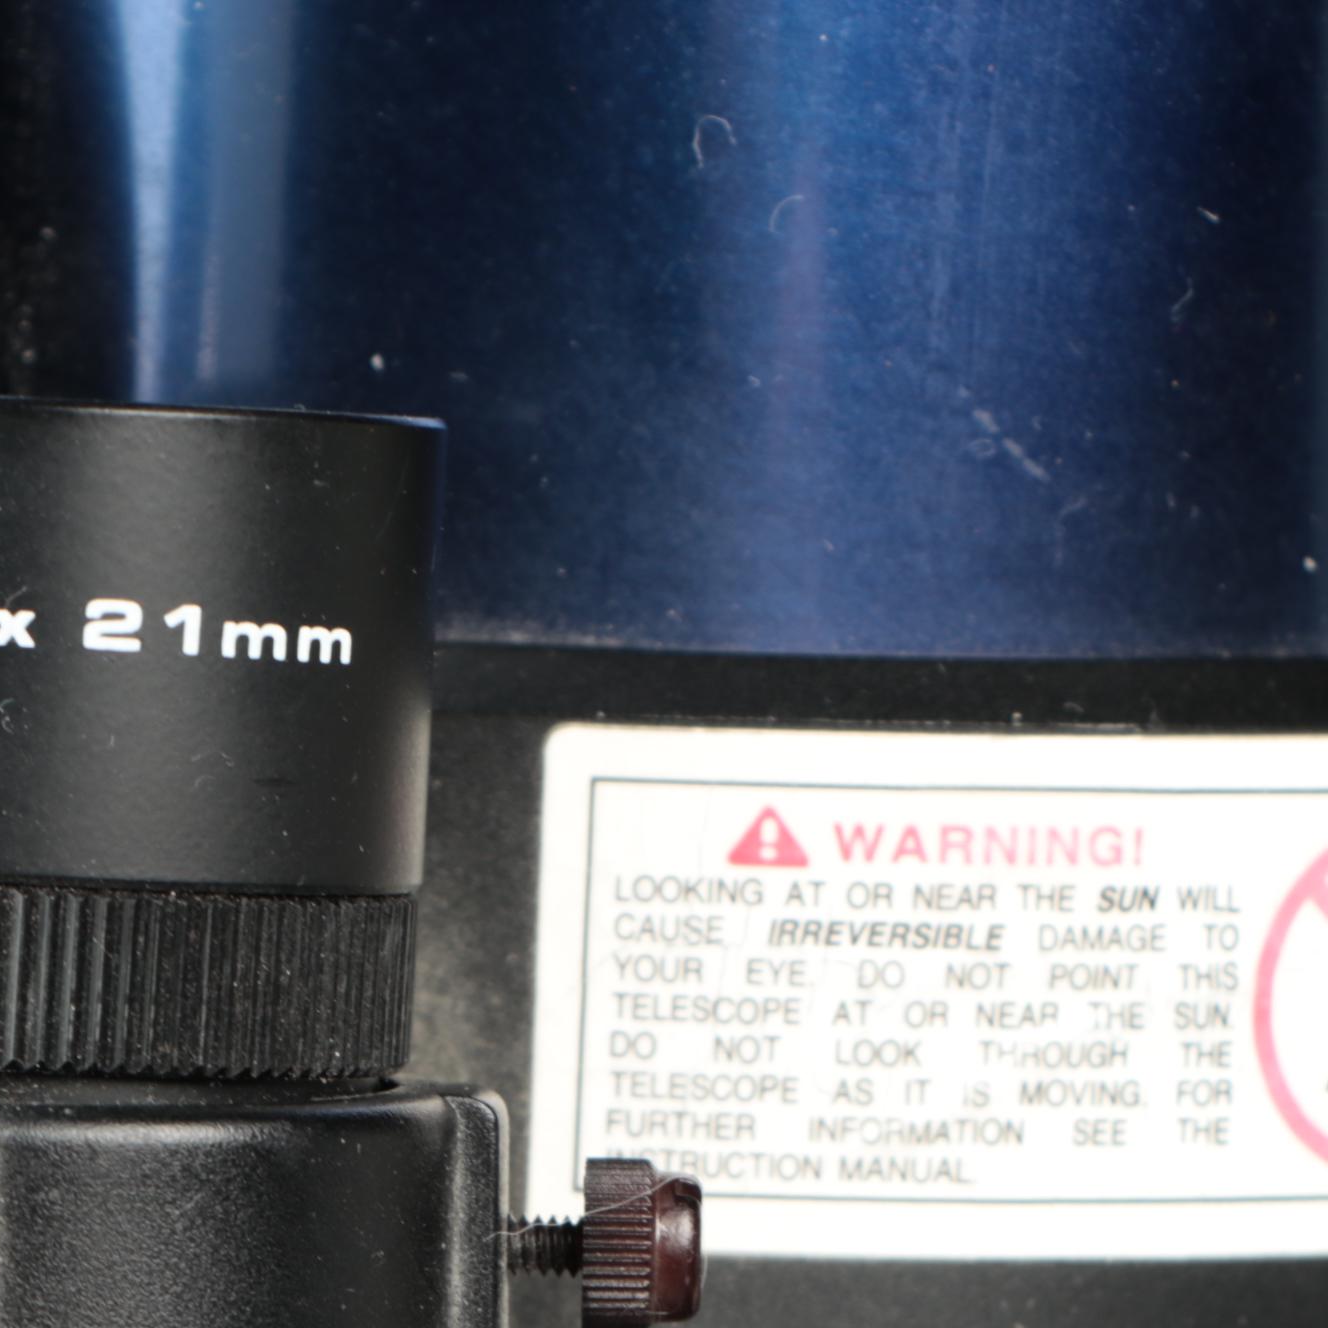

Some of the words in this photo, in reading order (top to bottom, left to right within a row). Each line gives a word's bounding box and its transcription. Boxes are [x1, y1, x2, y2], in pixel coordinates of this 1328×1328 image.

[83, 599, 353, 666] 21mm
[833, 822, 1144, 866] WARNING!
[613, 875, 765, 906] LOOKING
[784, 881, 826, 906] AT
[846, 881, 894, 909] OR
[912, 883, 997, 911] NEAR
[1017, 884, 1076, 912] THE
[1096, 886, 1161, 913] SUN
[1177, 886, 1241, 913] WILL
[613, 913, 724, 944] CAUSE
[767, 918, 1006, 951] IRREVERSIBLE
[1038, 923, 1167, 952] DAMAGE
[1203, 924, 1239, 951] TO
[613, 953, 704, 983] YOUR
[858, 960, 905, 989] DO
[945, 962, 1010, 990] NOT
[1048, 963, 1139, 991] POINT
[1179, 963, 1239, 991] THIS
[613, 992, 801, 1025] TELESCOPE
[832, 1000, 872, 1026] AT
[903, 1001, 949, 1029] OR
[974, 1001, 1060, 1030] NEAR
[1088, 1002, 1146, 1030] THE
[609, 1030, 657, 1060] DO
[714, 1034, 781, 1064] NOT
[835, 1039, 922, 1067] LOOK
[978, 1041, 1129, 1068] THROUGH
[1180, 1041, 1233, 1068] THE
[610, 1070, 800, 1103] TELESCOPE
[834, 1077, 874, 1105] AS
[906, 1079, 931, 1106] IT
[963, 1080, 991, 1108] IS
[1177, 1078, 1233, 1107] FOR
[606, 1108, 756, 1141] FURTHER
[808, 1117, 1025, 1146] INFORMATION
[1073, 1118, 1127, 1146] SEE
[1177, 1117, 1231, 1146] THE
